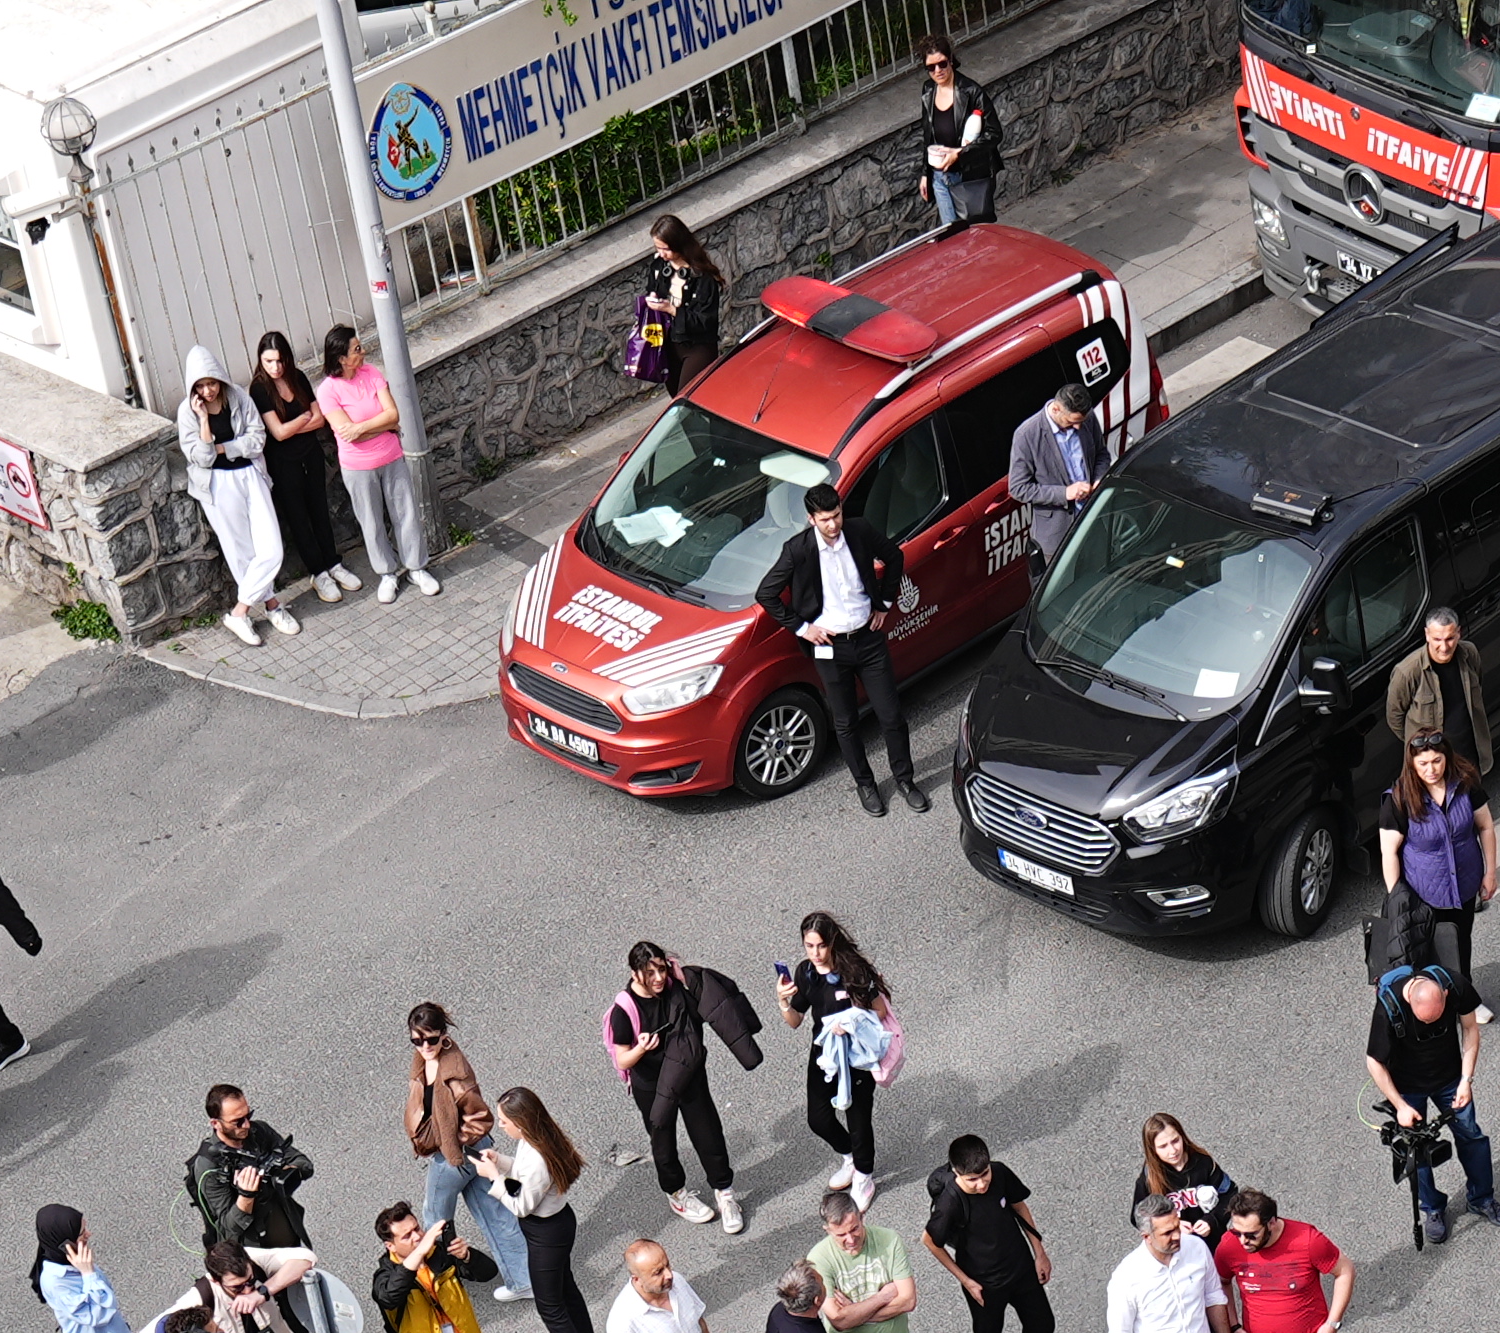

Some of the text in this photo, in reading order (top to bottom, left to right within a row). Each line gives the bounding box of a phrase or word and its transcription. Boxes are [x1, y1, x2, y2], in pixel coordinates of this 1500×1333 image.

[455, 31, 587, 163] MEHMETÇİK
[647, 0, 783, 70] TEMSİLCİL
[1367, 128, 1450, 182] İTFAİYE
[1082, 346, 1103, 369] 112
[984, 502, 1032, 552] İSTAN
[988, 534, 1030, 576] İTFAİ
[553, 602, 646, 652] İTFAİYESİ
[572, 585, 663, 634] İSTANBUL
[534, 718, 550, 738] 34
